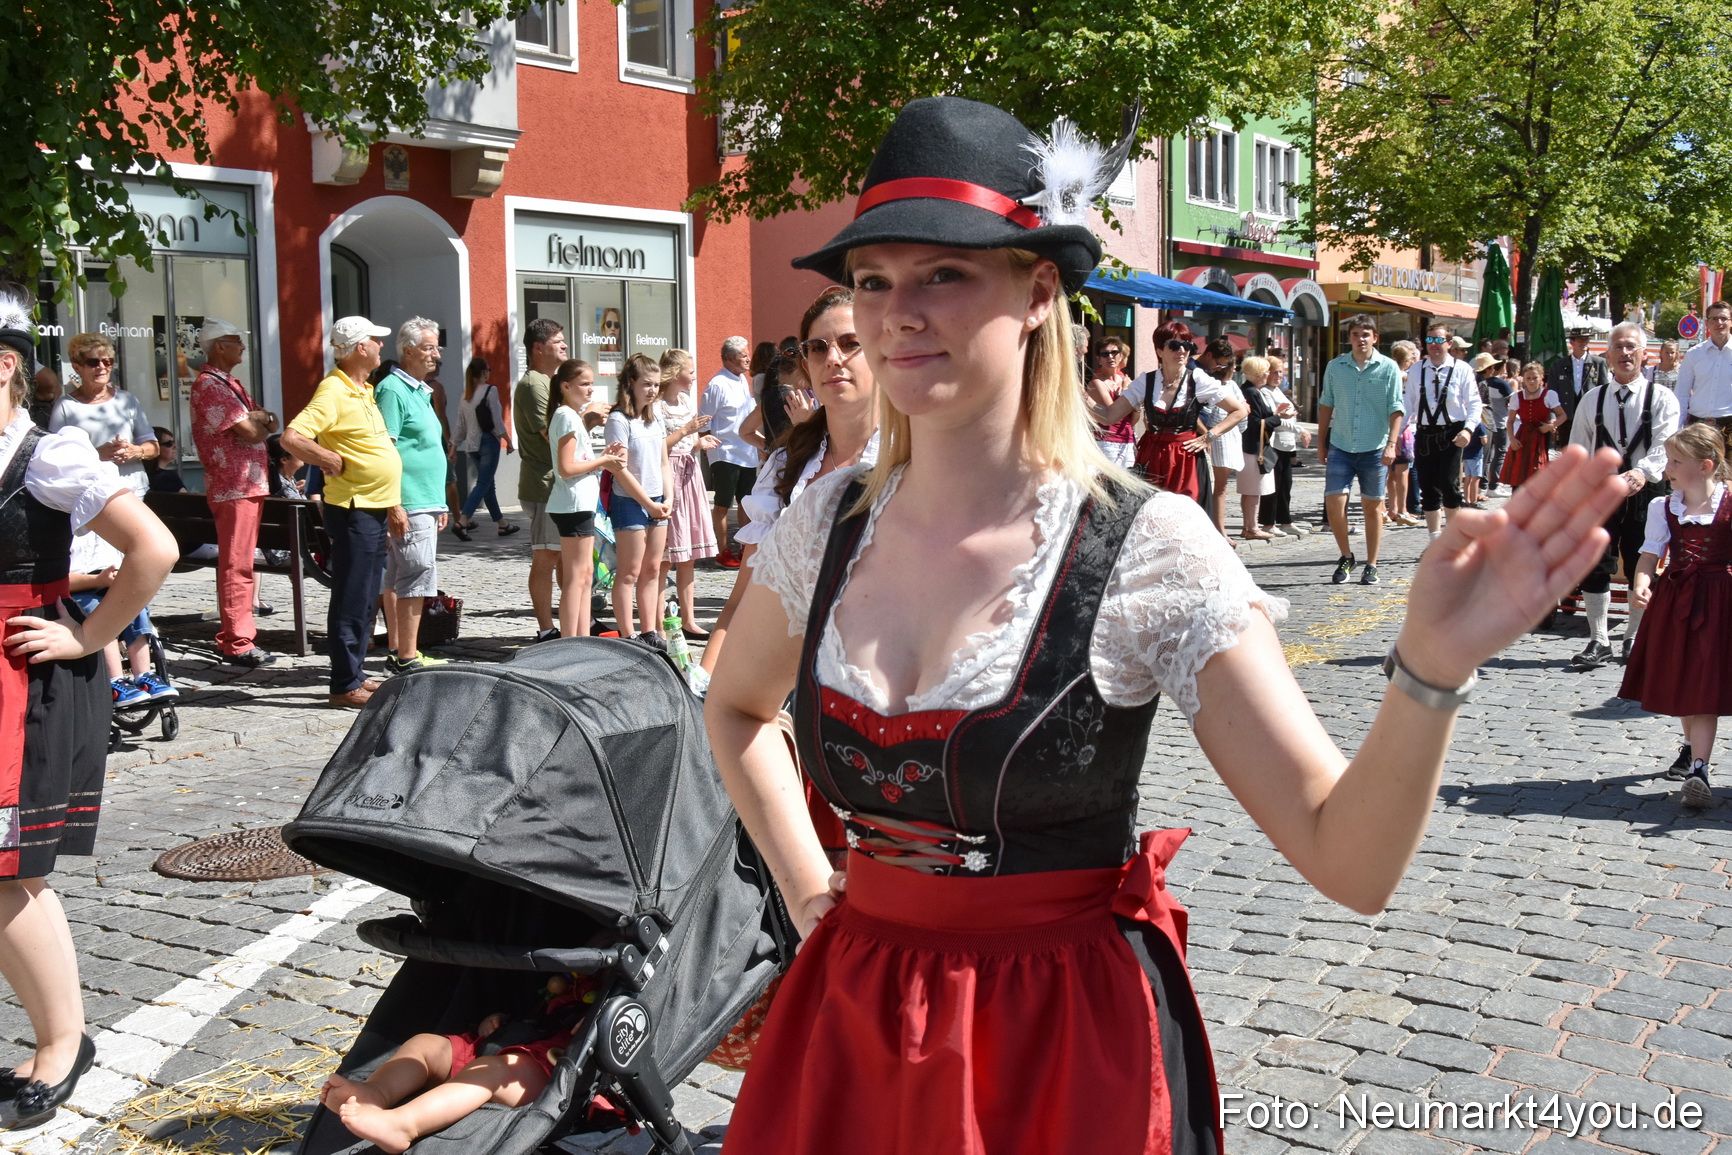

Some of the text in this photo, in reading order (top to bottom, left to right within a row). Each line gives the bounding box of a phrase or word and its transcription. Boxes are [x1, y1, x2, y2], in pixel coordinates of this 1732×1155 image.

[548, 233, 645, 270] fielmann
[1396, 267, 1439, 292] ROMSTOCK
[99, 322, 154, 338] fielmann
[582, 333, 616, 345] fielmann
[636, 334, 667, 346] fielmann
[615, 1024, 629, 1044] city
